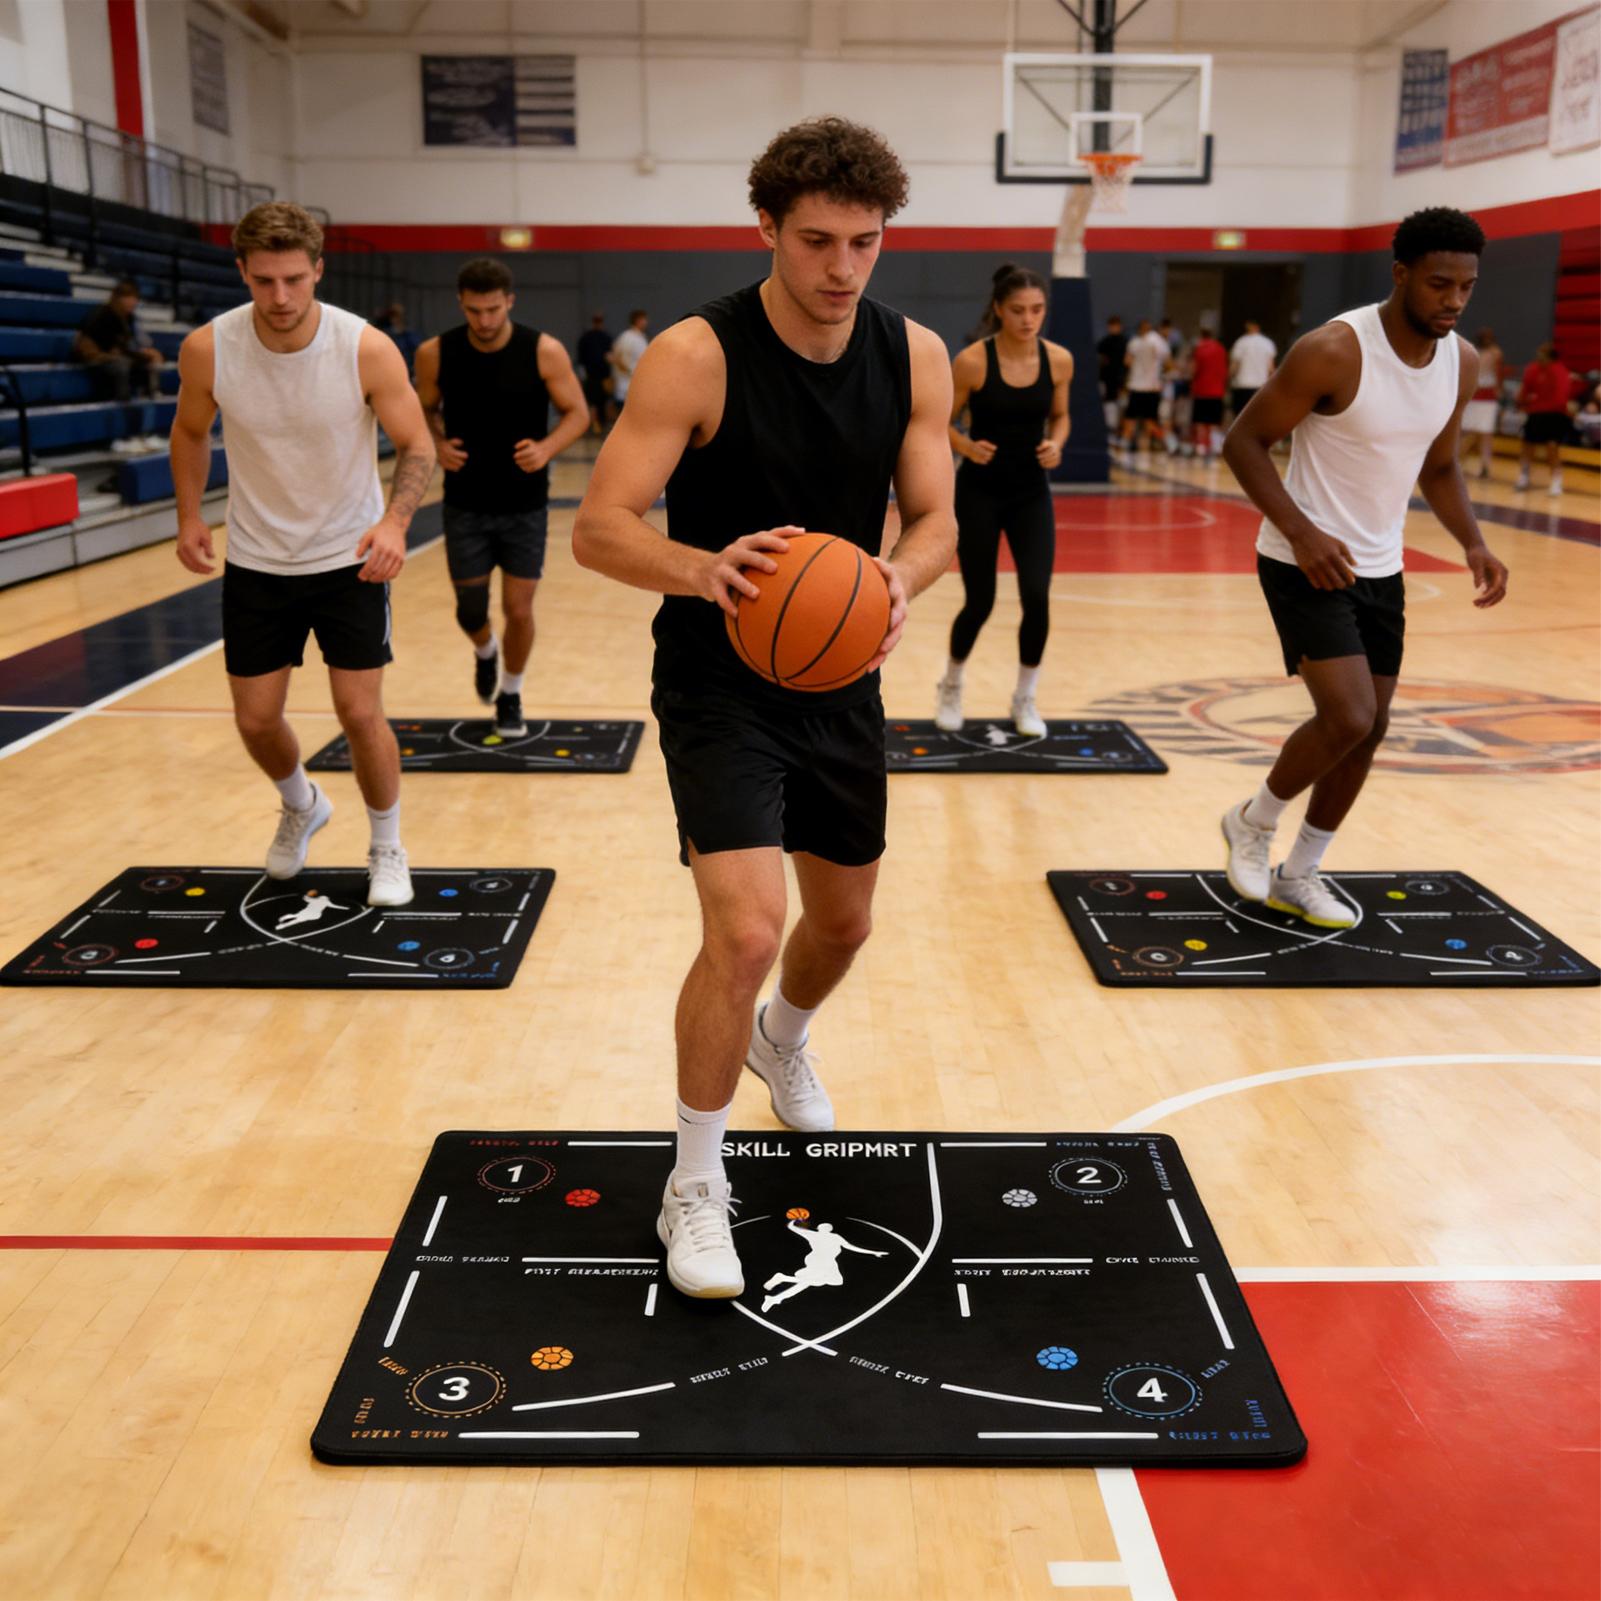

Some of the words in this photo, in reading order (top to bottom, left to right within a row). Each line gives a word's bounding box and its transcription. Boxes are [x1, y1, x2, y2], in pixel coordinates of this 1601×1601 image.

[721, 1142, 790, 1157] SKILL
[806, 1143, 916, 1157] GRIPMRT
[508, 1165, 522, 1182] 1
[1077, 1166, 1102, 1185] 2
[438, 1376, 470, 1401] 3
[1137, 1378, 1167, 1402] 4
